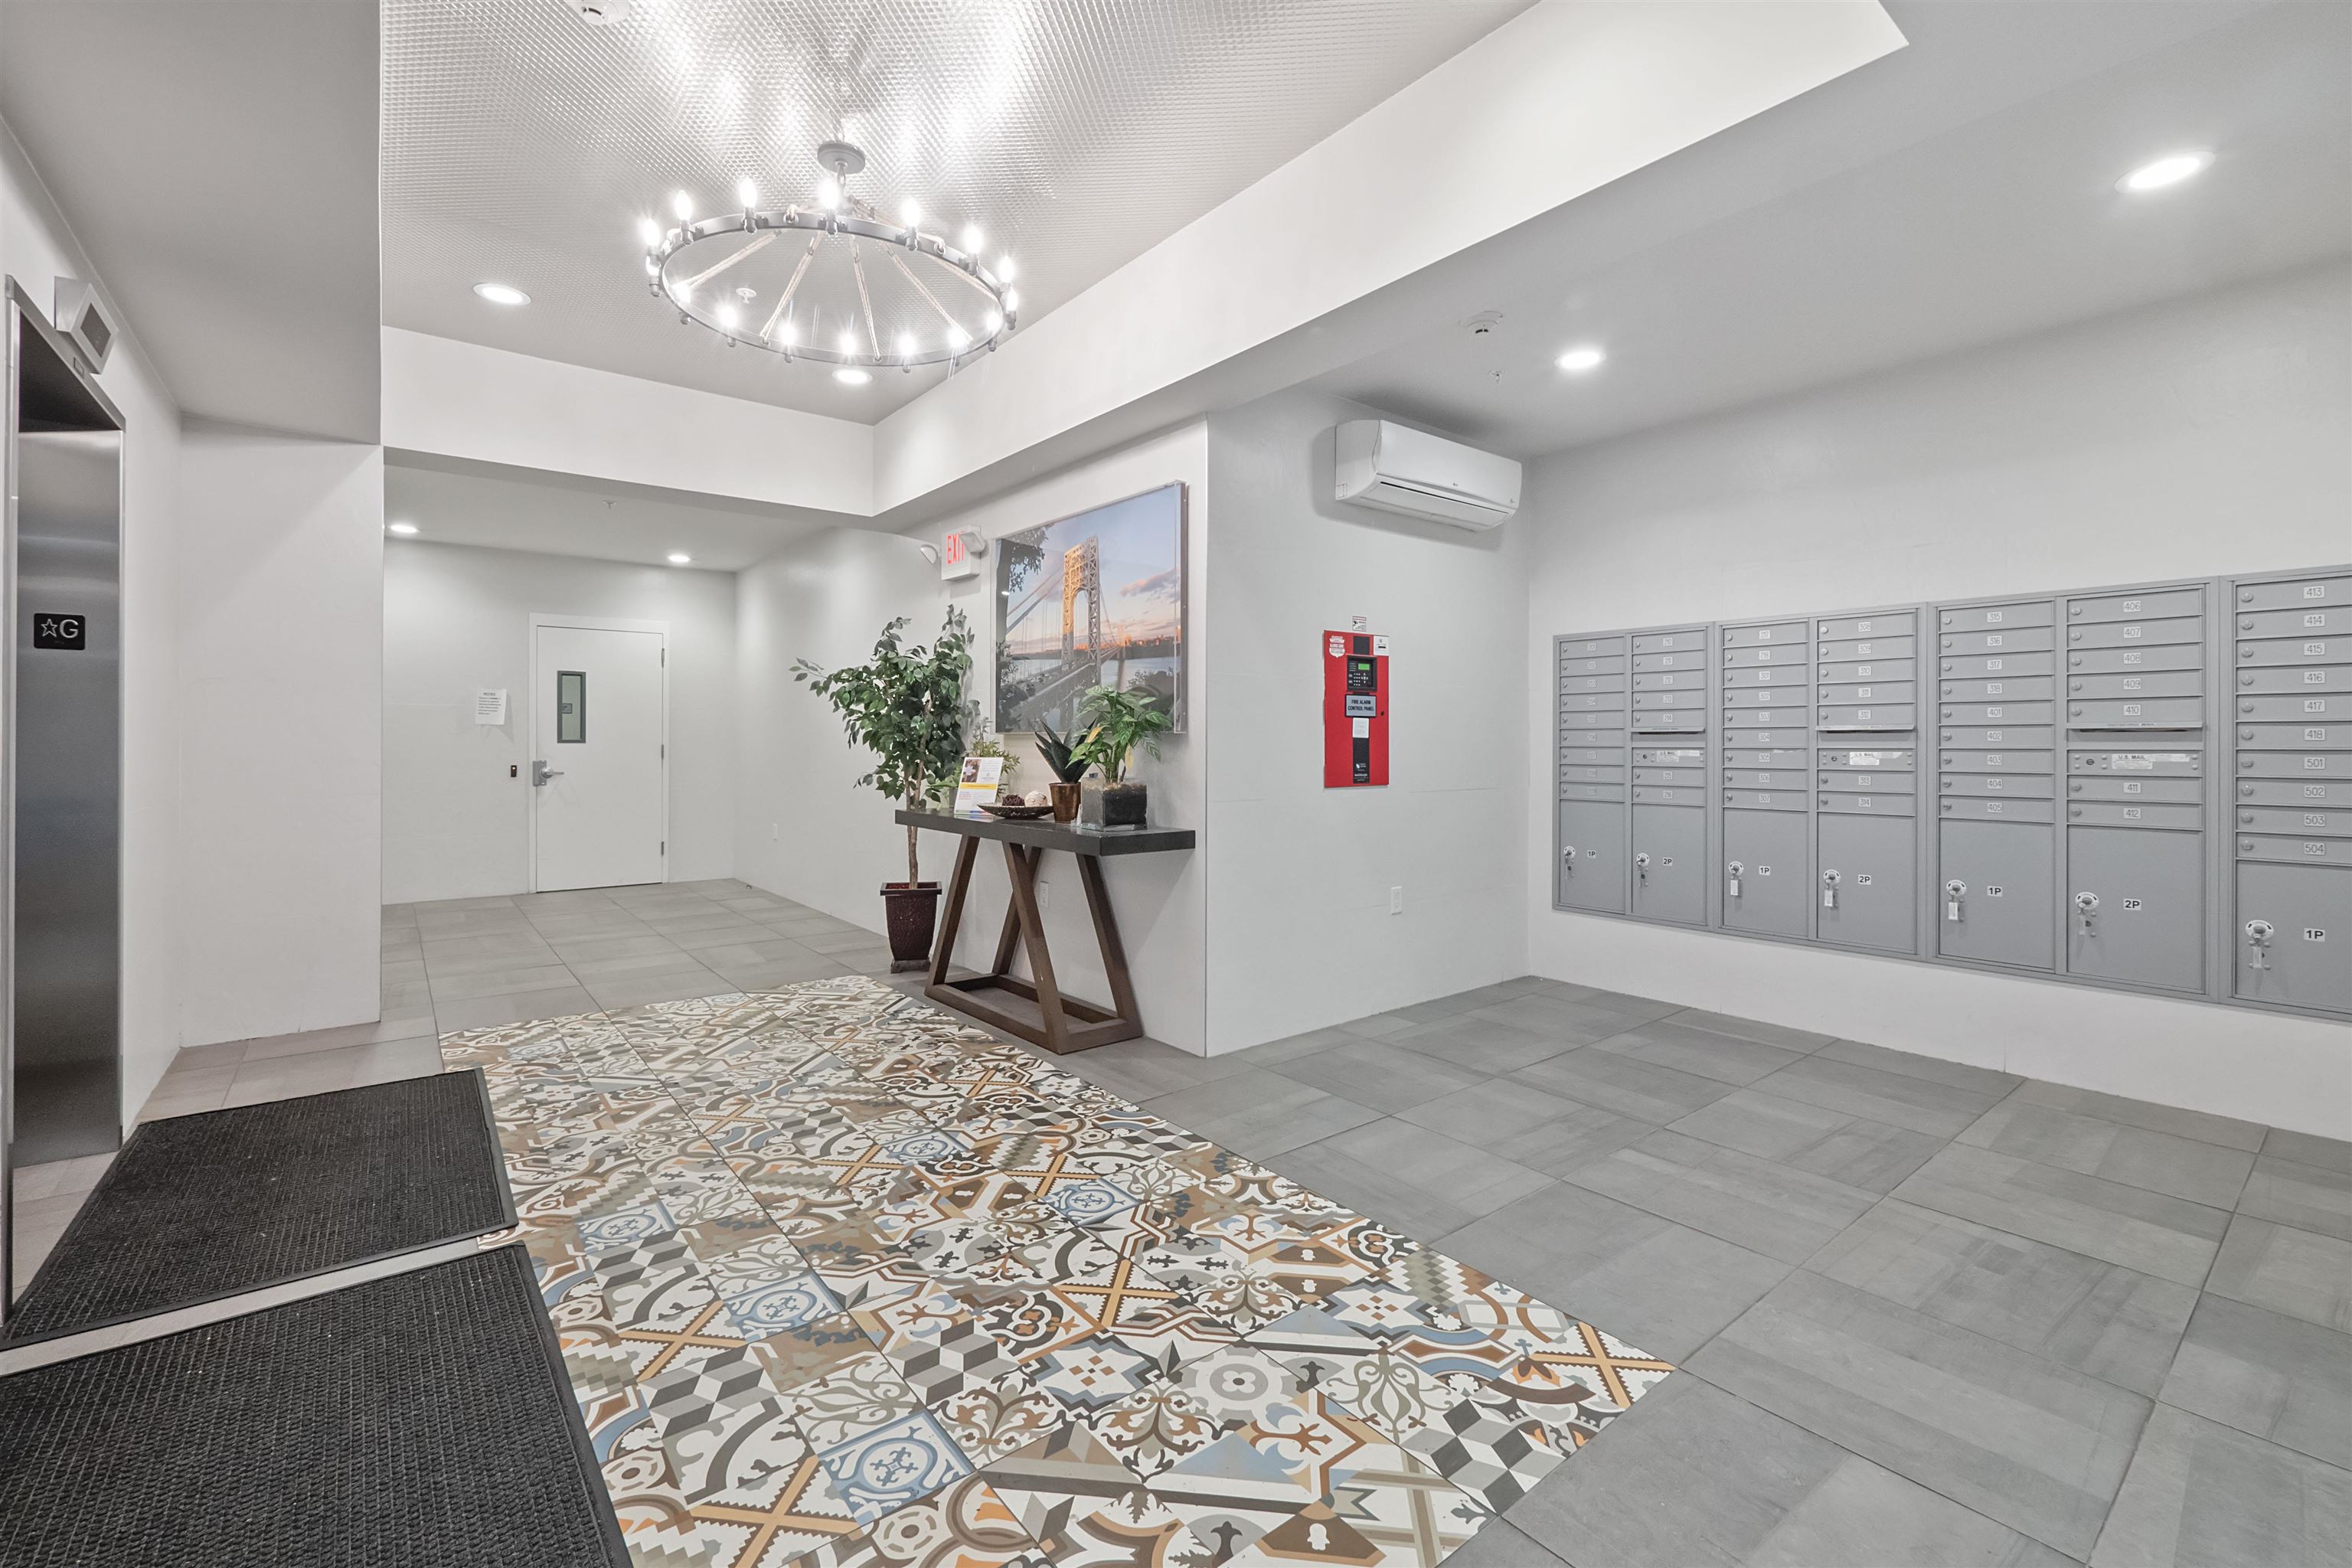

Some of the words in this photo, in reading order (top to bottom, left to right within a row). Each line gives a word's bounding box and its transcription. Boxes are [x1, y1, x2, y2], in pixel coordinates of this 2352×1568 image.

[2306, 587, 2321, 597] 413
[2125, 602, 2140, 611] 406
[1989, 612, 2001, 621] 315
[2307, 616, 2322, 625] 414
[60, 619, 78, 639] G
[2125, 628, 2140, 637] 407
[2306, 645, 2323, 654] 415
[2125, 654, 2140, 663] 408
[1990, 661, 2000, 669] 317
[2306, 673, 2323, 682] 416
[2125, 680, 2141, 688] 409
[2125, 706, 2139, 714] 410
[2307, 701, 2322, 710] 417
[1988, 732, 2001, 740] 402
[2307, 730, 2322, 739] 418
[2307, 759, 2323, 767] 501
[1989, 779, 2001, 788] 404
[2305, 787, 2324, 796] 502
[2125, 809, 2138, 818] 412
[2305, 815, 2324, 825] 503
[2305, 844, 2323, 854] 504
[2125, 900, 2140, 909] 2P
[2306, 930, 2323, 939] 1P
